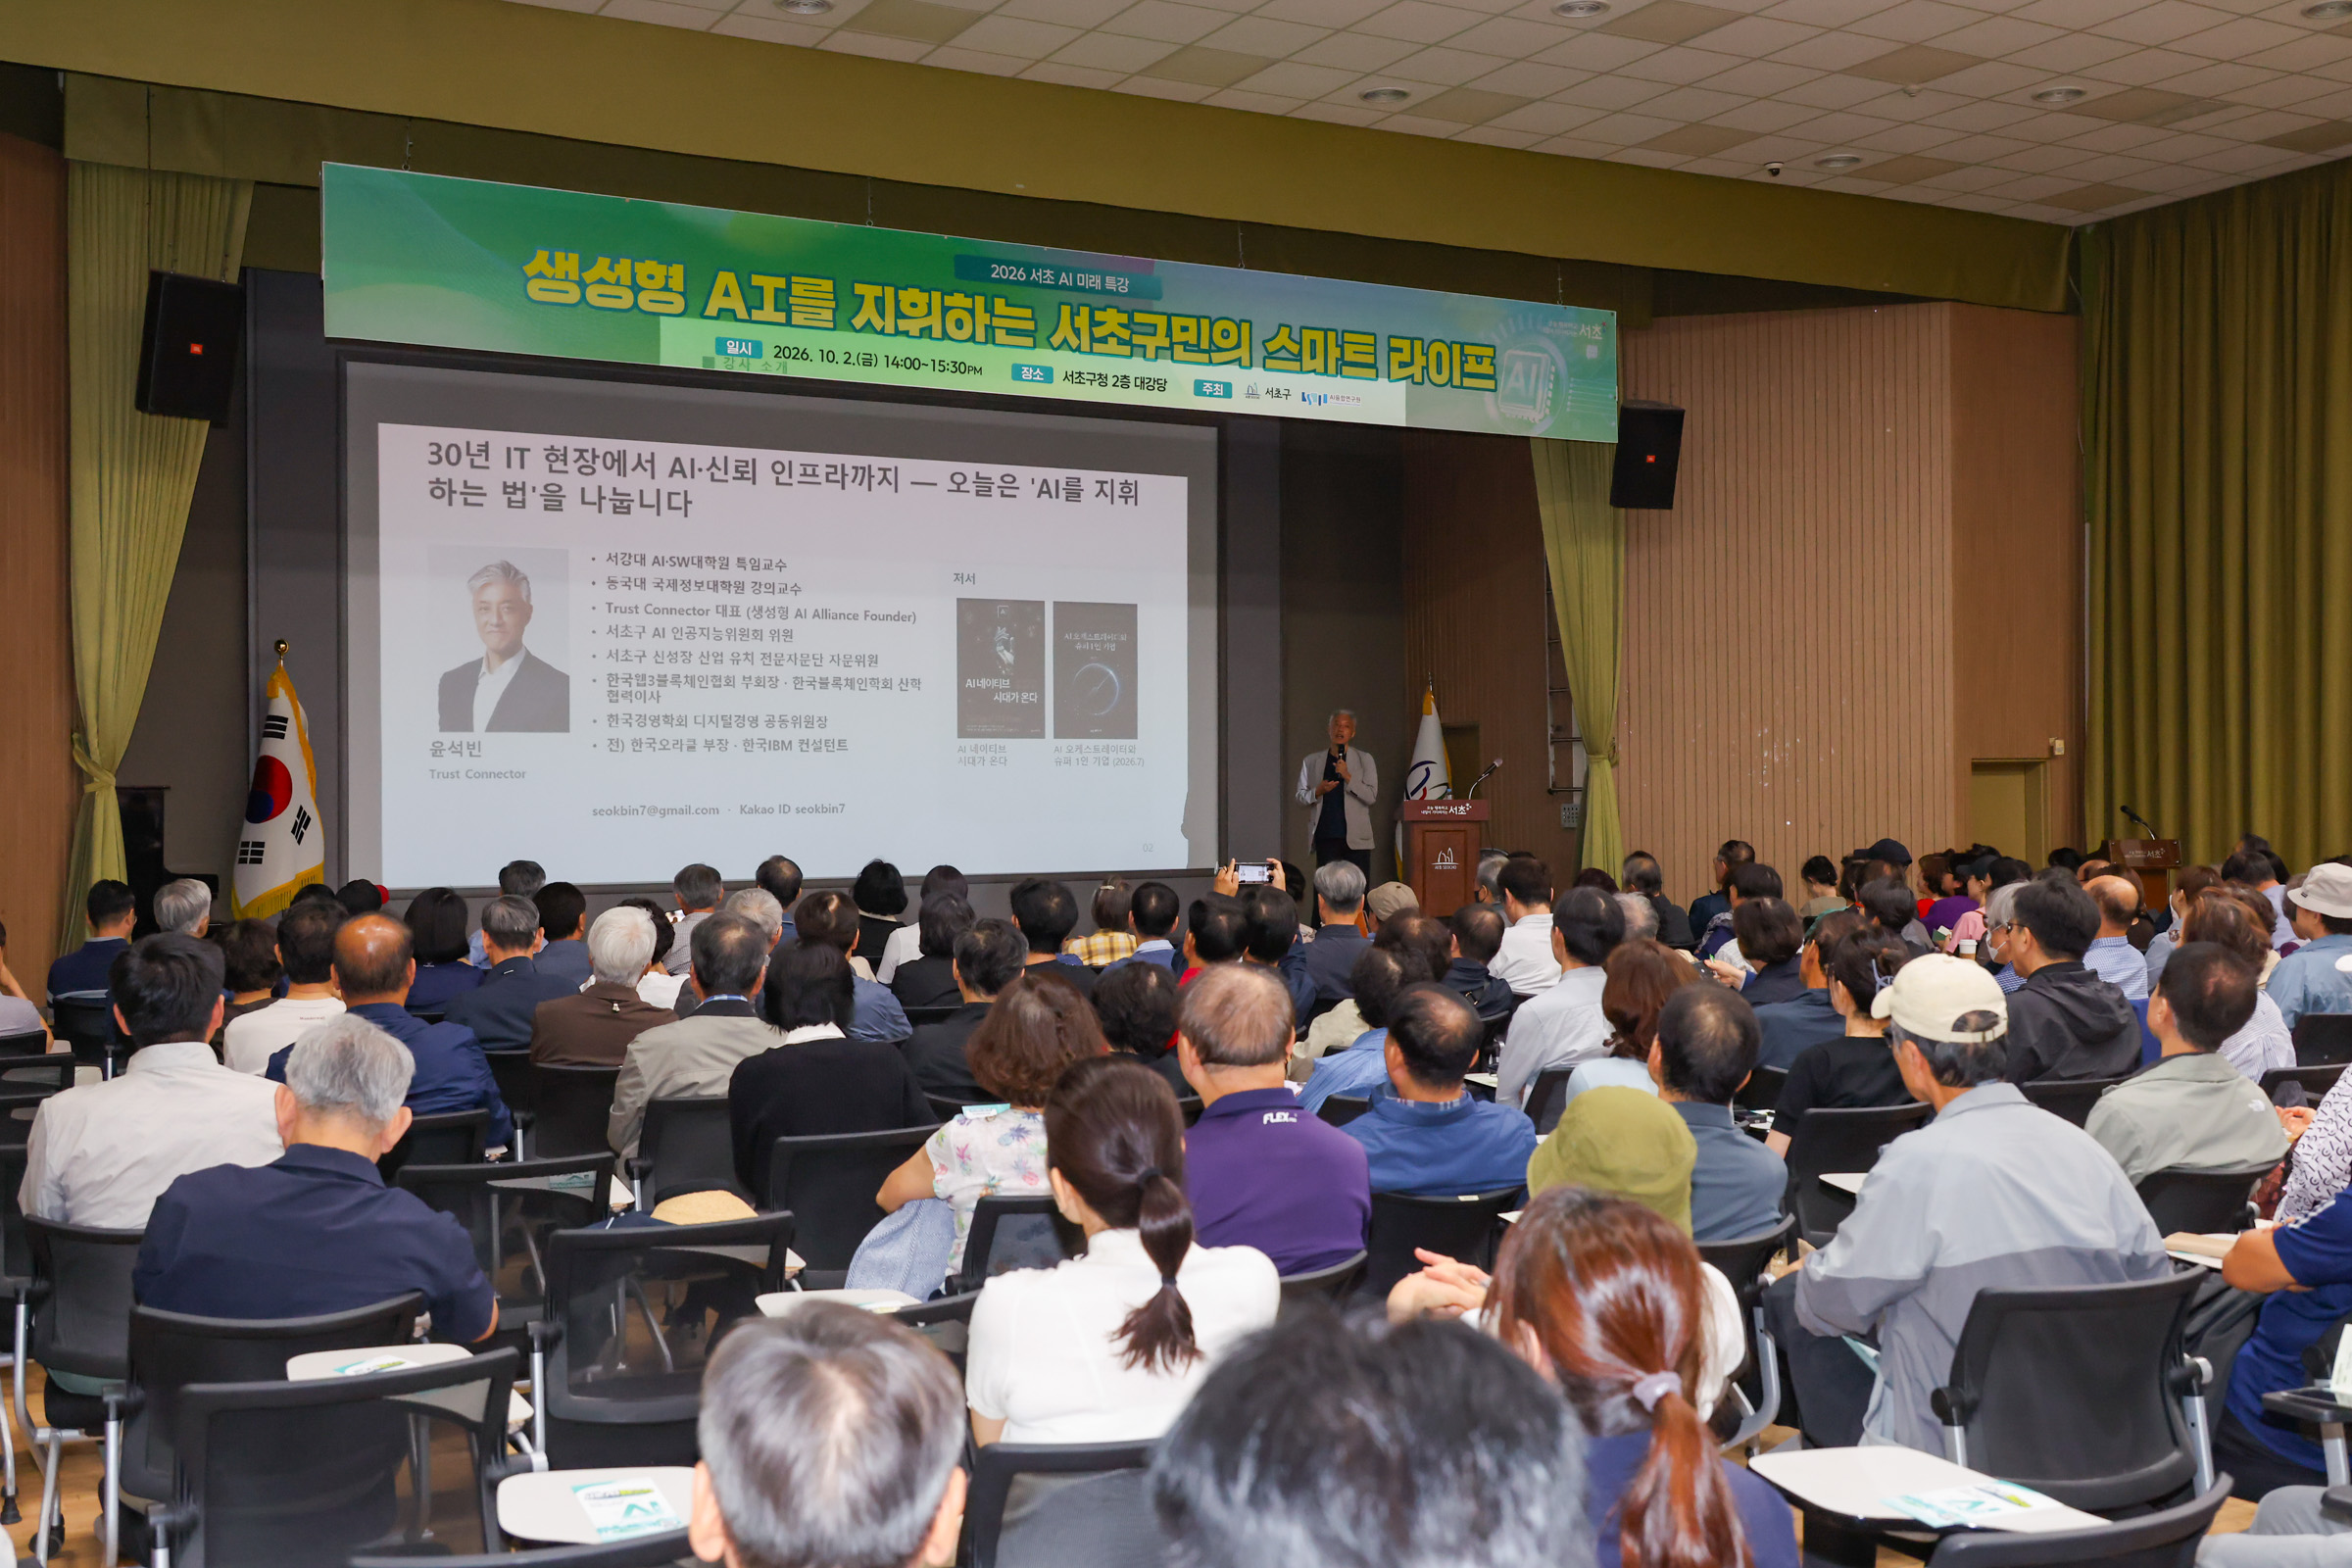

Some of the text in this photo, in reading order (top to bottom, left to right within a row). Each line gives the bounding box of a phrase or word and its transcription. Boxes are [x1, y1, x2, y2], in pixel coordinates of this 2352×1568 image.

[991, 264, 1129, 293] 2026 서초 AI 미래 특강
[523, 248, 1497, 390] 생성형 AI를 지휘하는 서초구민의 스마트 라이프
[1579, 323, 1602, 340] 서초
[726, 339, 752, 356] 일시
[773, 345, 813, 363] 2026.
[818, 349, 838, 365] 10.
[843, 352, 878, 368] 2.(금)
[723, 357, 788, 374] 강사 소개
[1021, 367, 1167, 392] 장소 서초구청 2층 대강당
[1505, 361, 1538, 396] AI
[1202, 382, 1223, 396] 주최
[1265, 387, 1292, 401] 서초구
[427, 441, 491, 470] 30년
[506, 447, 531, 469] IT
[543, 445, 657, 480] 현장에서
[667, 456, 758, 485] AI·신뢰
[771, 460, 900, 493] 인프라까지
[947, 471, 1020, 499] 오늘은
[1031, 476, 1085, 503] 'AI를
[1095, 478, 1139, 507] 지휘
[428, 477, 693, 518] 하는 법'을 나눕니다
[606, 552, 788, 572] 서강대 AI·SW대학원 특임교수
[606, 575, 803, 596] 동국대 국제정보대학원 강의교수
[954, 572, 976, 585] 저서
[606, 602, 917, 624] Trust Connector 대표 (생성형 AI Alliance Founder)
[606, 624, 794, 642] 서초구 AI 인공지능위원회 위원
[606, 650, 879, 667] 서초구 신성장 산업 유치 전문자문단 자문위원
[741, 674, 780, 689] 부회장
[792, 675, 893, 691] 한국블록체인학회
[898, 677, 922, 692] 산학
[965, 678, 1010, 689] AI 네이티브
[607, 690, 662, 705] 협력이사
[993, 692, 1039, 704] 시대가 온다
[607, 713, 828, 730] 한국경영학회 디지털경영 공동위원장
[429, 740, 482, 759] 윤석빈
[607, 738, 849, 753] 전) 한국오라클 부장 한국IBM 컨설턴트
[957, 744, 1007, 755] AI 네이티브
[1054, 745, 1137, 755] AI 오케스트레이터와
[957, 756, 1007, 766] 시대가 온다
[1054, 757, 1145, 767] 슈퍼 1인 기업 (2026.7)
[429, 768, 527, 780] Trust Connector
[592, 804, 719, 818] seokbin7@gmail.com
[739, 804, 846, 815] Kakao ID seokbin7
[1449, 805, 1466, 815] 서초
[1143, 843, 1153, 853] 02
[1263, 1111, 1290, 1125] FLEX
